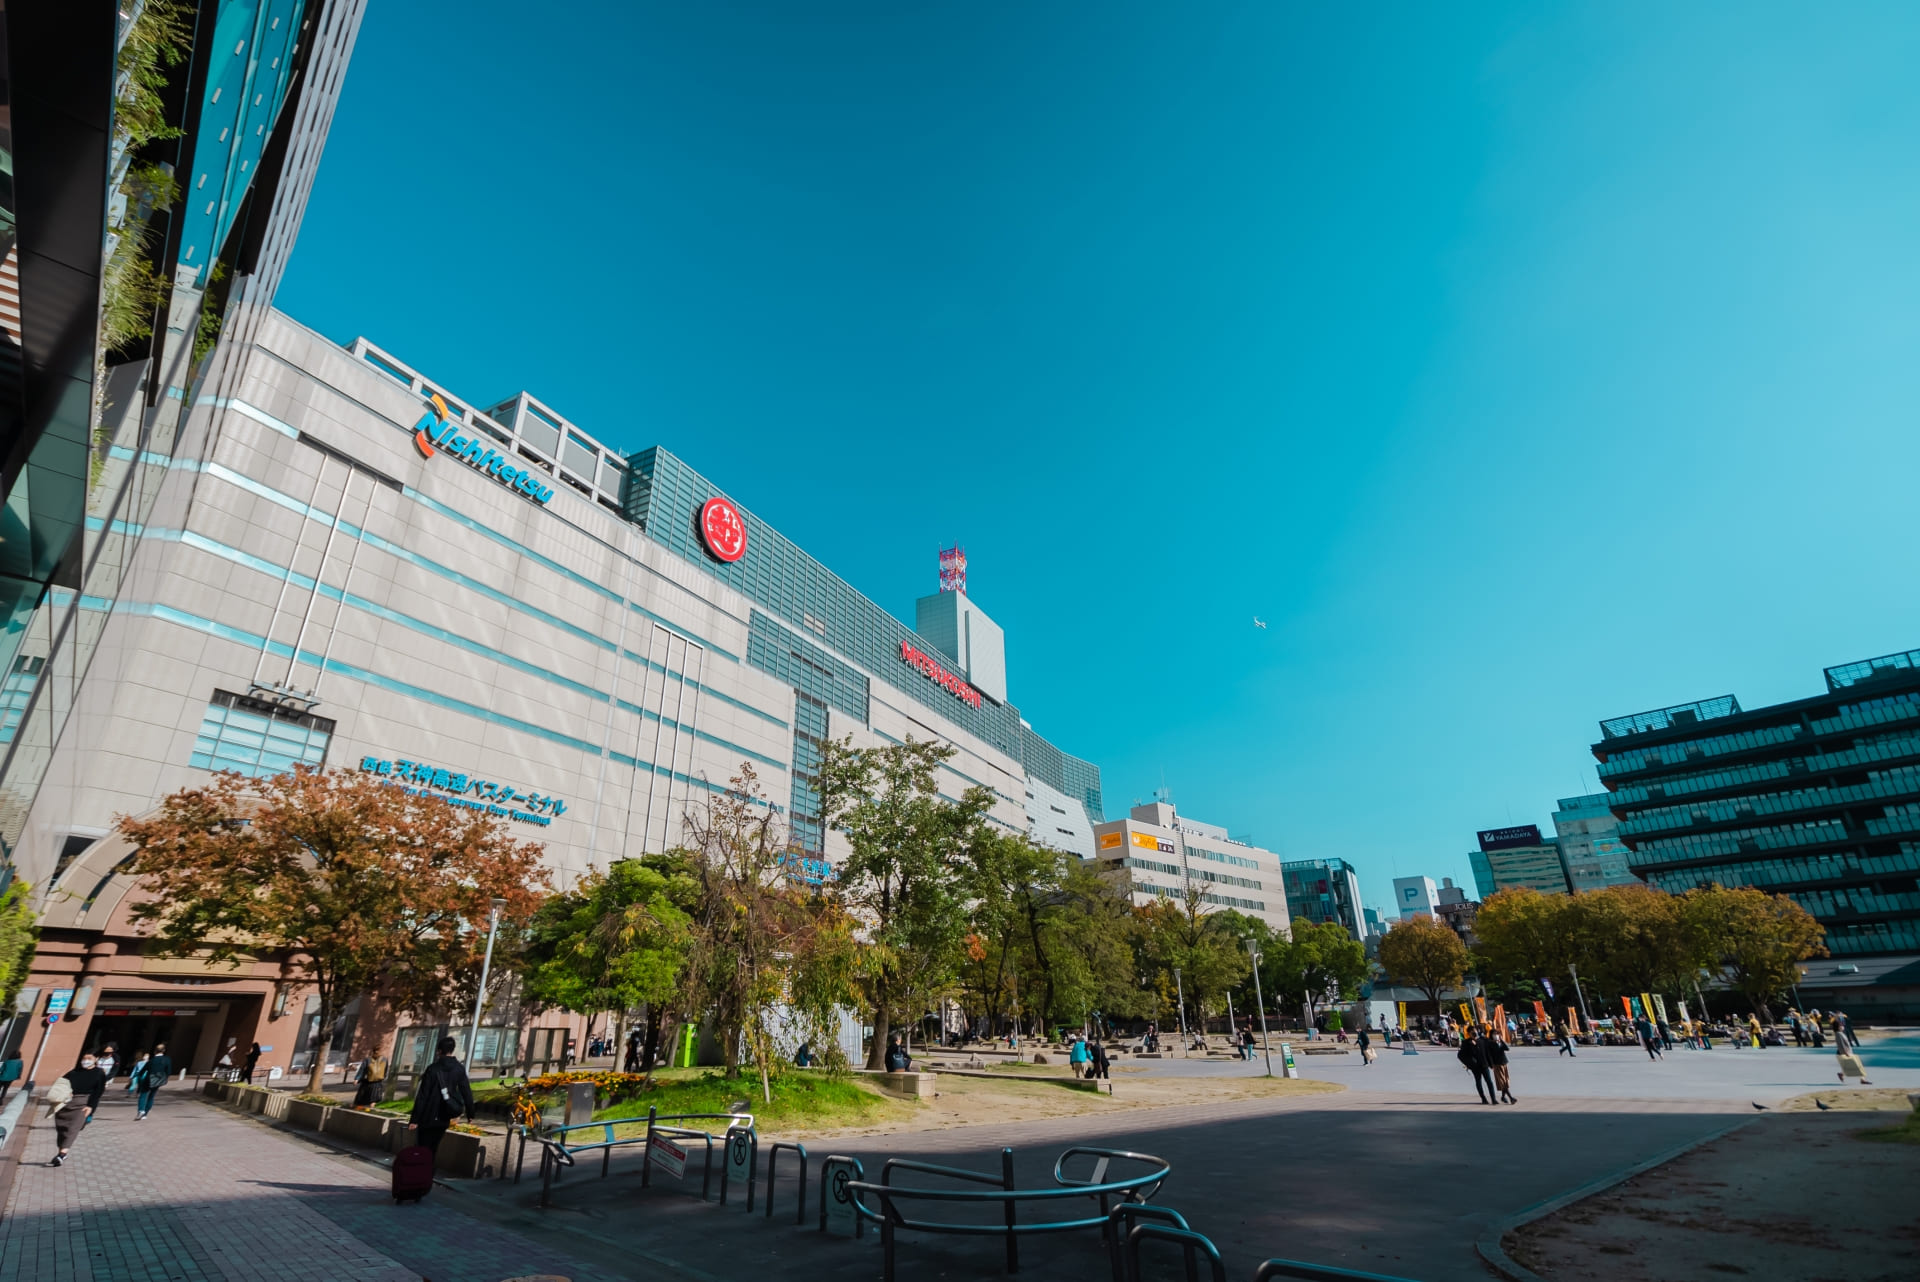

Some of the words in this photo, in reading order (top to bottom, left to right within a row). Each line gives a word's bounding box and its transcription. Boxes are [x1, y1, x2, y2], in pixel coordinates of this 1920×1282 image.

[415, 411, 555, 504] Nishitetsu
[902, 640, 981, 709] MITSUKOSHI
[511, 808, 551, 826] Terminal
[1403, 887, 1418, 902] P
